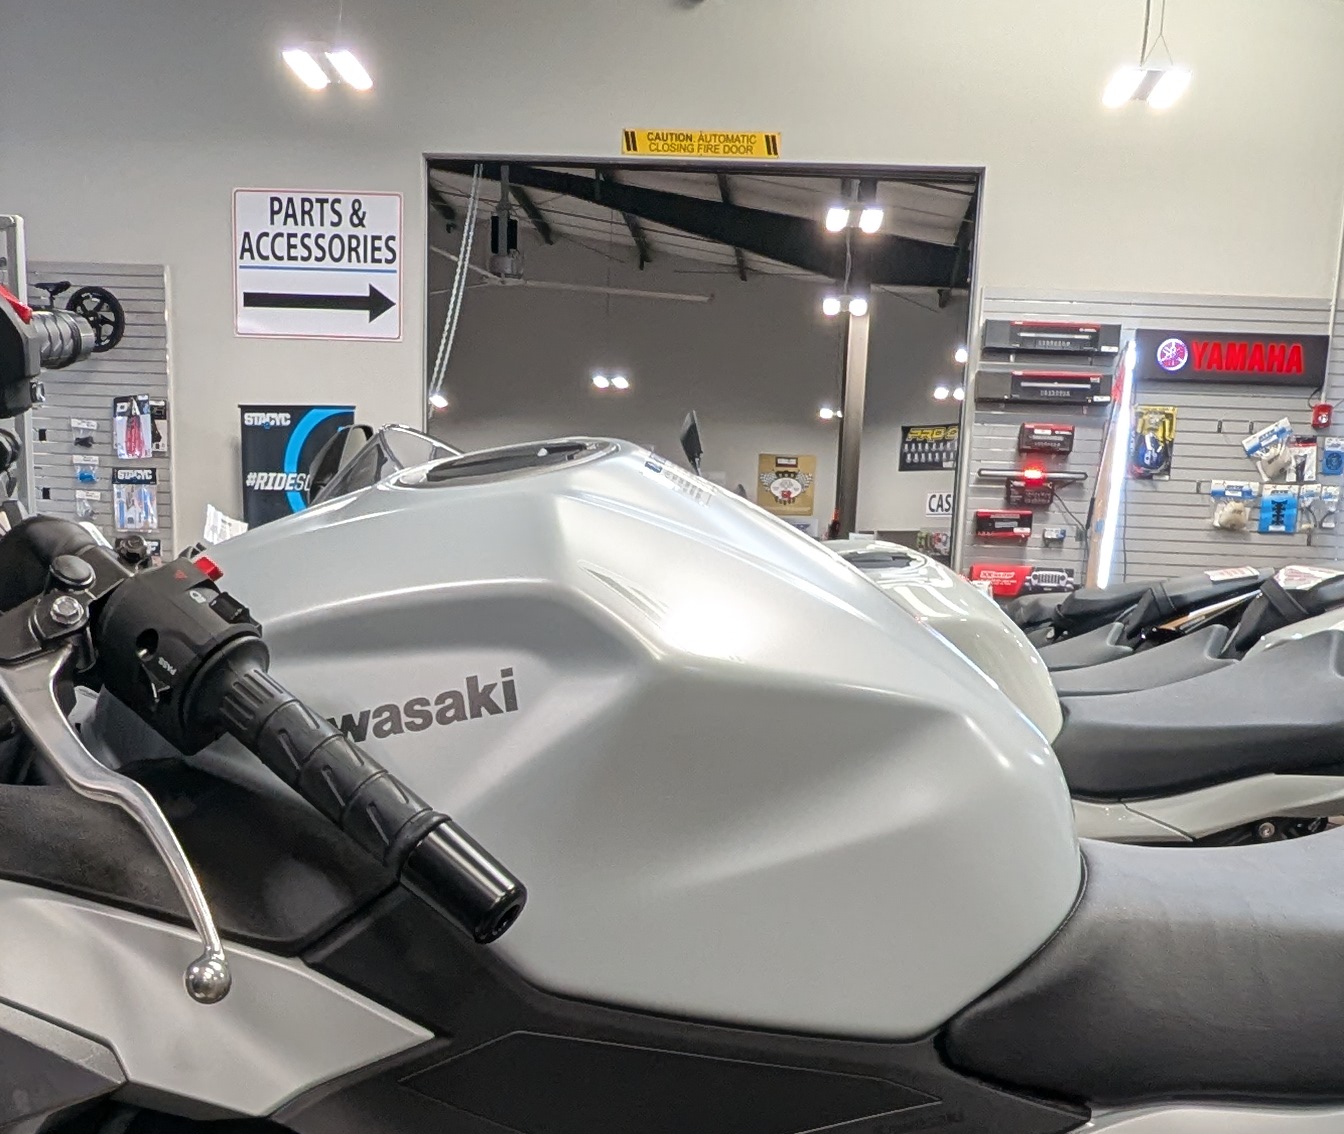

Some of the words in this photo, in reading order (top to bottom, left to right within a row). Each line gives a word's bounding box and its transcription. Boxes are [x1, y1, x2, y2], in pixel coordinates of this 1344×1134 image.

[648, 142, 695, 153] CLOSING
[697, 143, 719, 154] FIRE
[723, 144, 754, 155] DOOR
[698, 133, 757, 145] AUTOMATIC
[269, 196, 343, 228] PARTS
[349, 198, 367, 228] &
[239, 231, 397, 265] ACCESSORIES
[1191, 340, 1304, 374] YAMAHA
[244, 412, 291, 429] STACYC
[326, 666, 519, 743] wasaki
